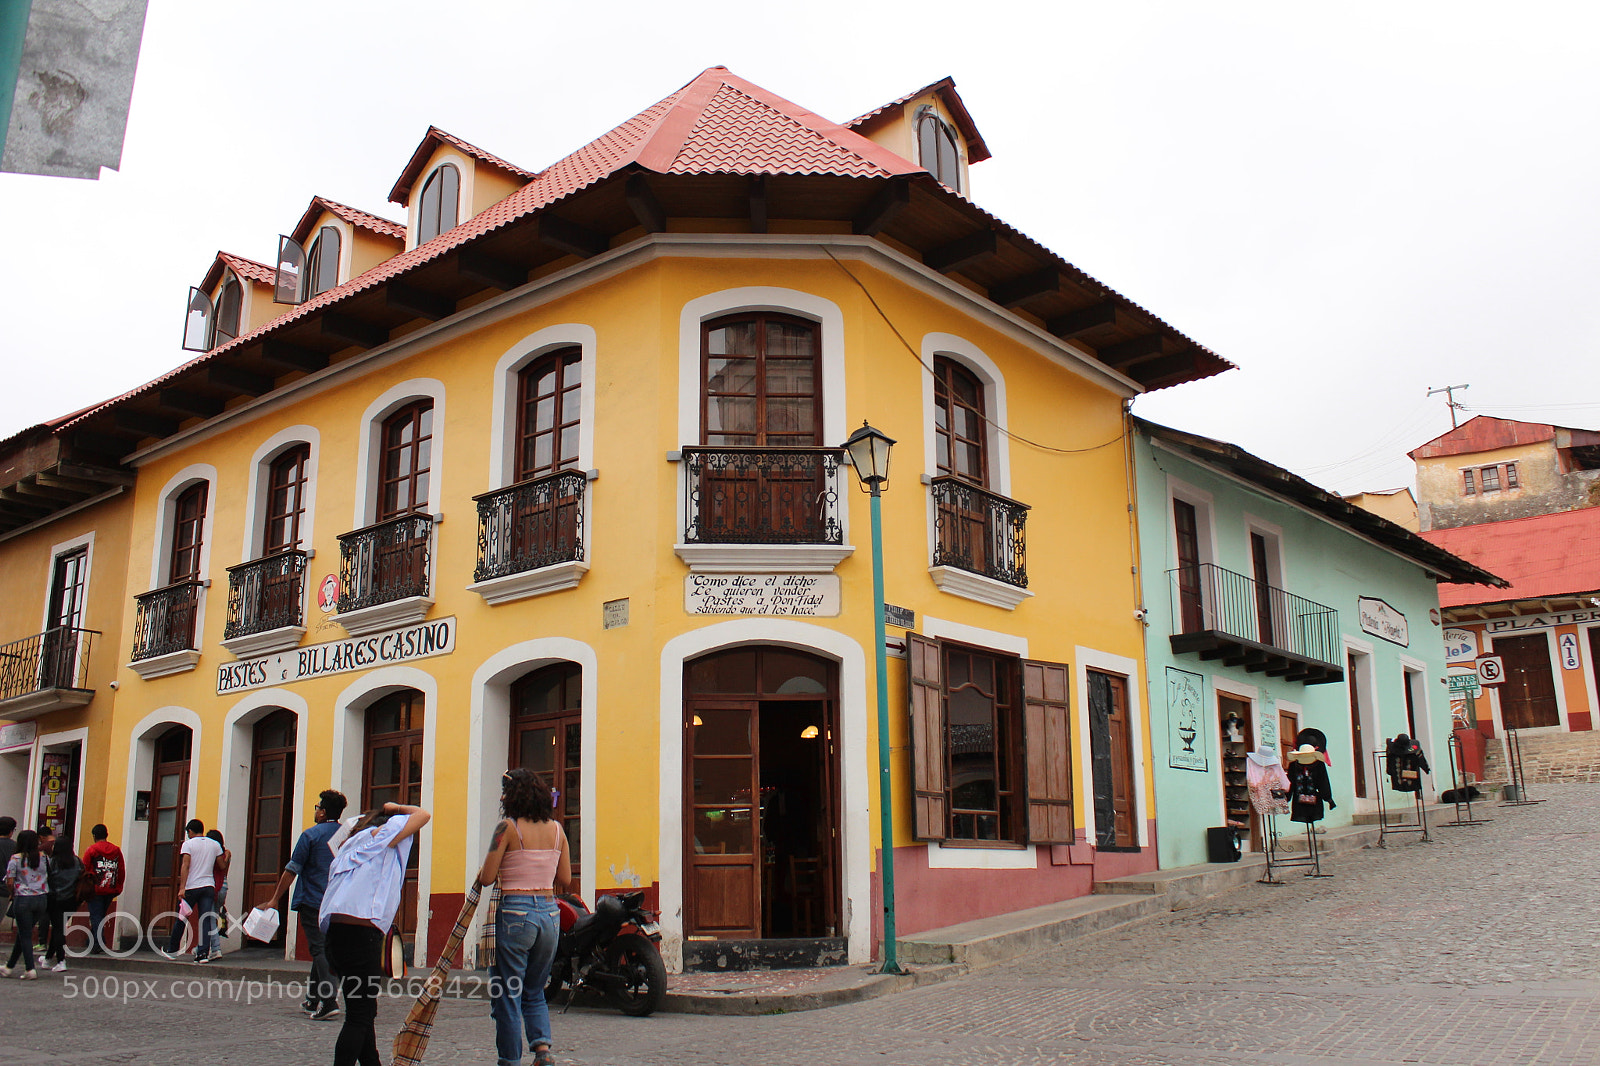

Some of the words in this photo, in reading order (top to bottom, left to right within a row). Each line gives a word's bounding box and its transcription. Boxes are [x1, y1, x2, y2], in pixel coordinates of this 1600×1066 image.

[732, 575, 756, 588] dice
[765, 575, 777, 586] el
[691, 585, 711, 596] Le
[723, 587, 763, 598] quieren
[702, 595, 745, 607] Pastes
[757, 597, 765, 605] a
[740, 606, 756, 614] que
[772, 605, 788, 615] los
[217, 659, 269, 691] PASTES
[296, 637, 379, 679] BILLARES
[380, 622, 449, 661] CASINO
[1445, 646, 1460, 657] le
[45, 764, 62, 831] HOTEL
